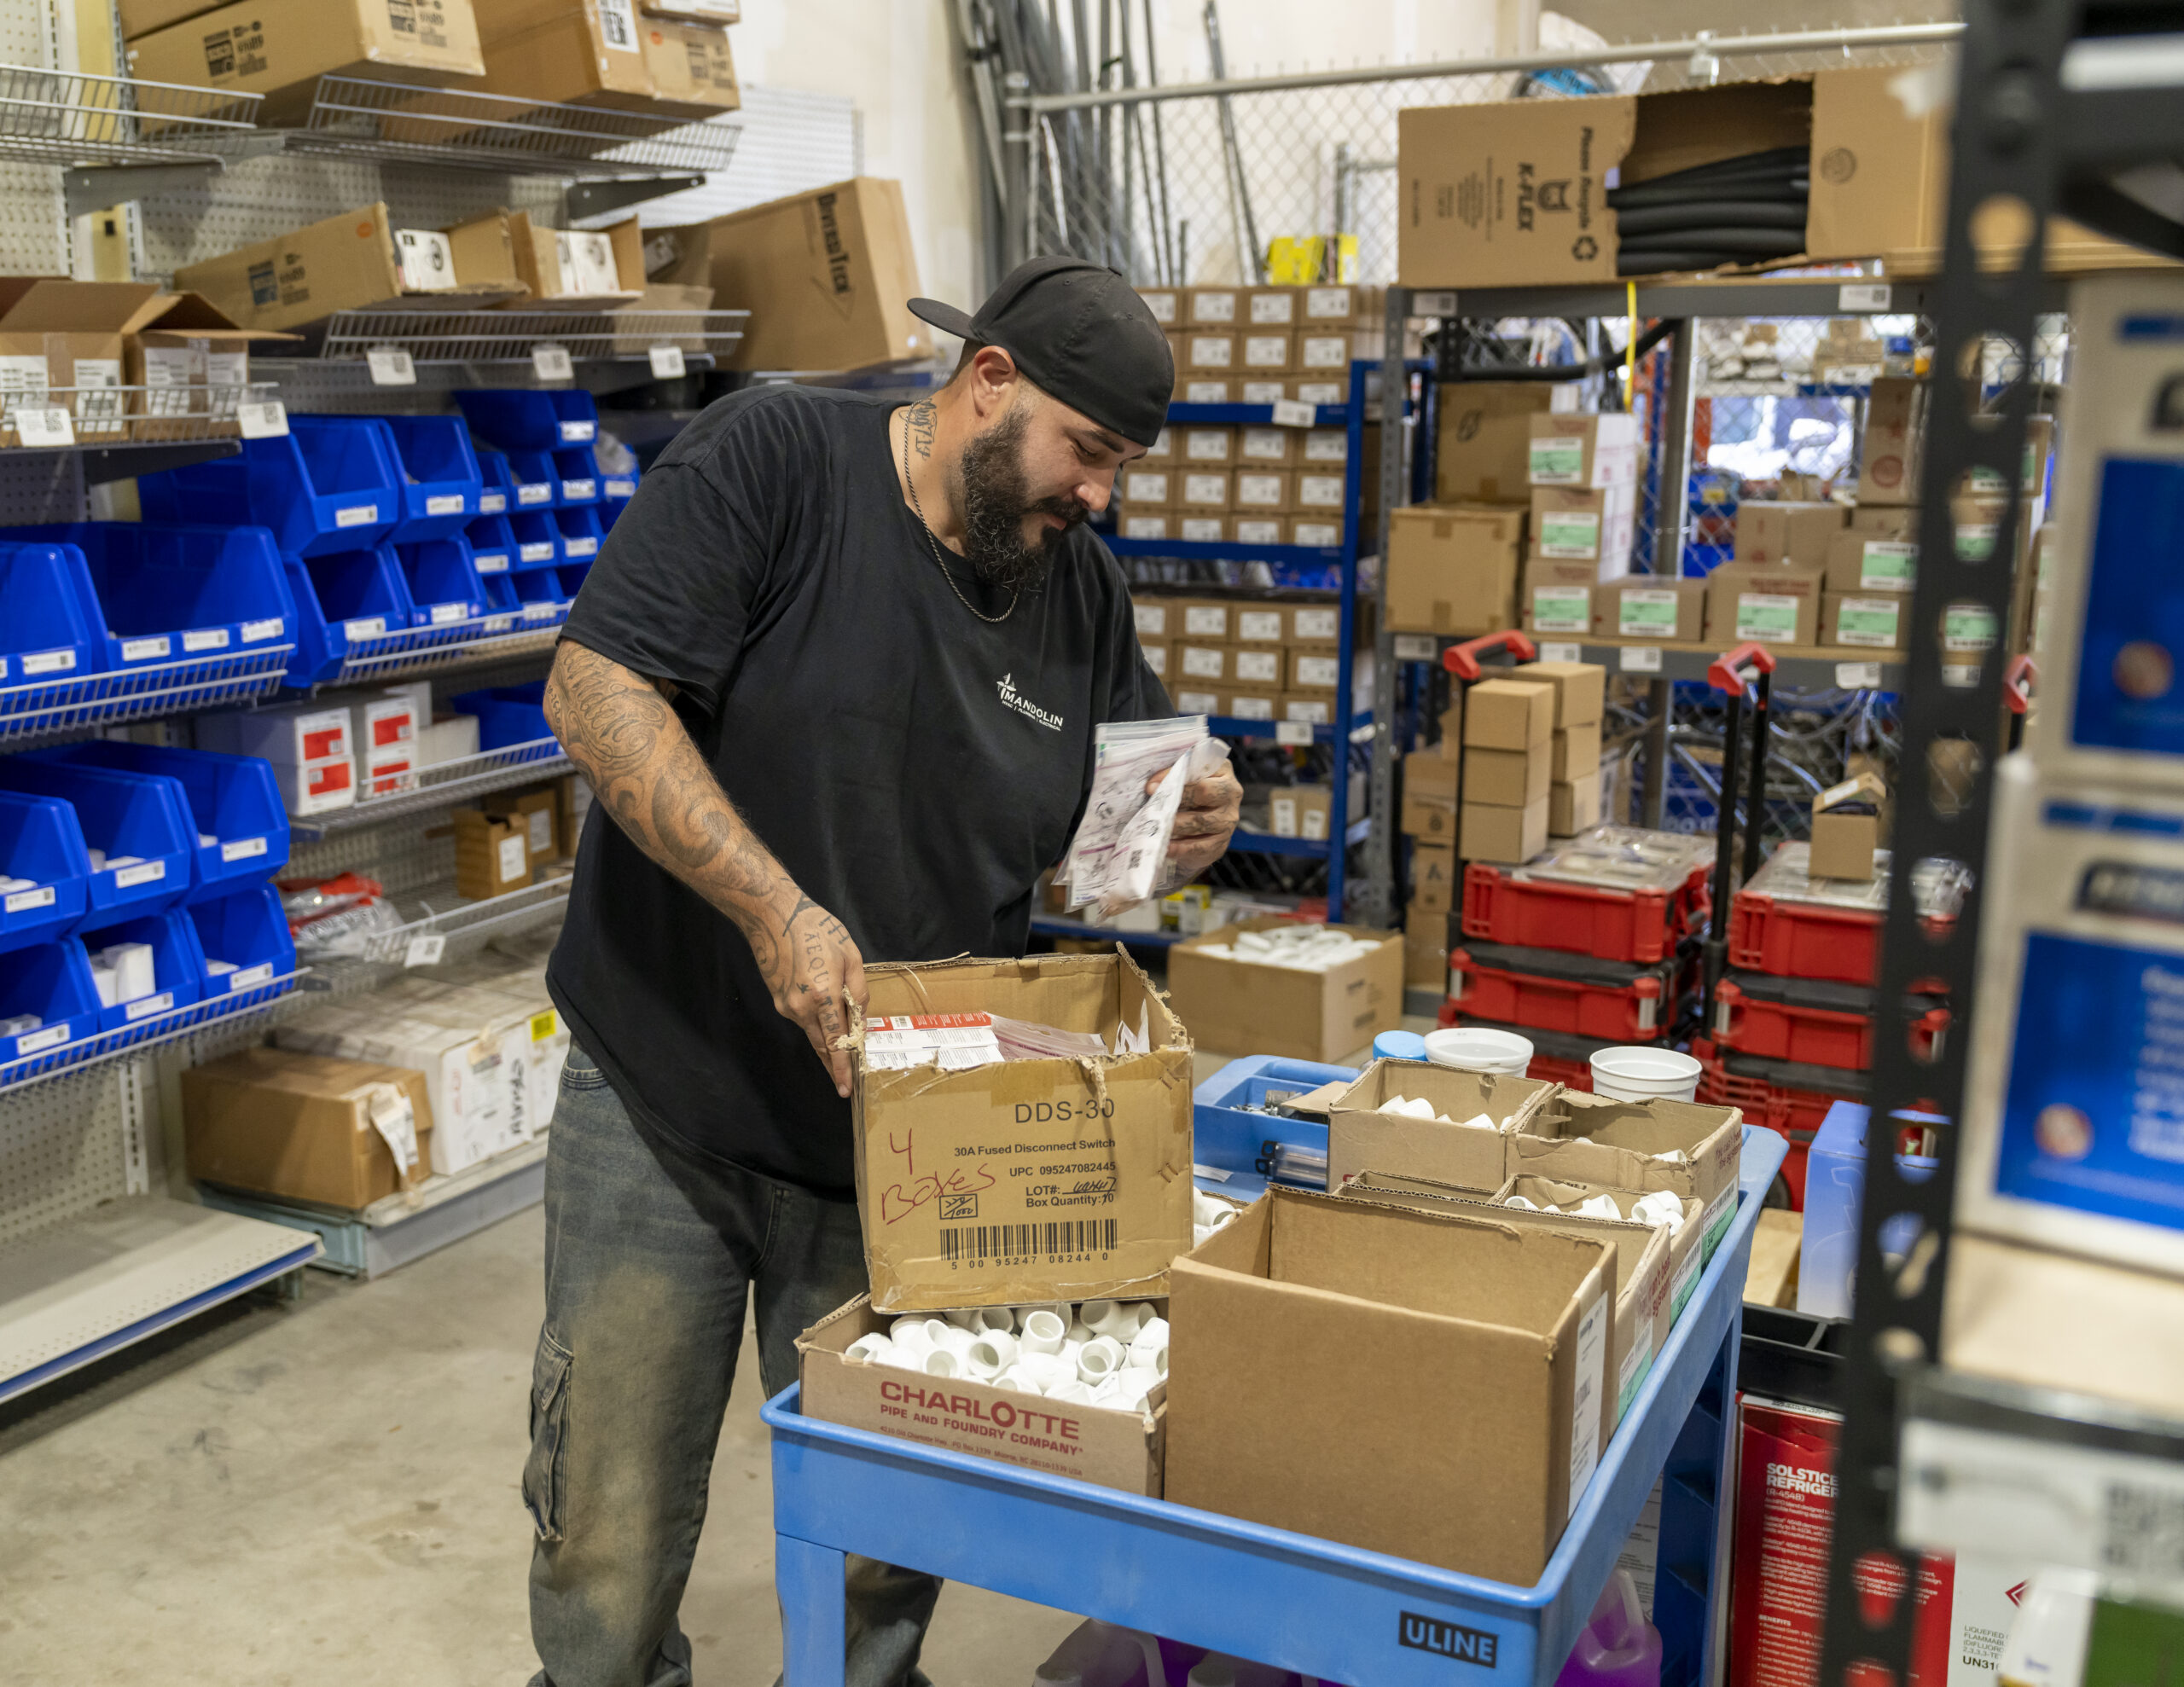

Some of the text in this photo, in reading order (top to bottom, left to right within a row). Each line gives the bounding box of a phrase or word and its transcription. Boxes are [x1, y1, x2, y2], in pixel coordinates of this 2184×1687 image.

[1517, 162, 1534, 232] K-FLEX
[1004, 691, 1064, 727] MANDOLIN
[1015, 1099, 1116, 1123] DDS-30
[889, 1128, 914, 1175] 4
[954, 1138, 1116, 1157] 30A Fused Disconnect Switch
[1010, 1162, 1116, 1177] UPC 095247082445
[1025, 1186, 1060, 1196] LOT#:
[1026, 1197, 1048, 1208] Box
[951, 1252, 1108, 1271] 5 00 95247 08244 0
[880, 1381, 1079, 1441] CHARLOTTE
[880, 1404, 908, 1419] PIPE
[913, 1412, 938, 1425] AND
[944, 1417, 1006, 1441] FOUNDRY
[1767, 1463, 1838, 1487] SOLSTICE
[1406, 1618, 1494, 1662] ULINE
[1964, 1625, 2005, 1639] LIQUEFIED
